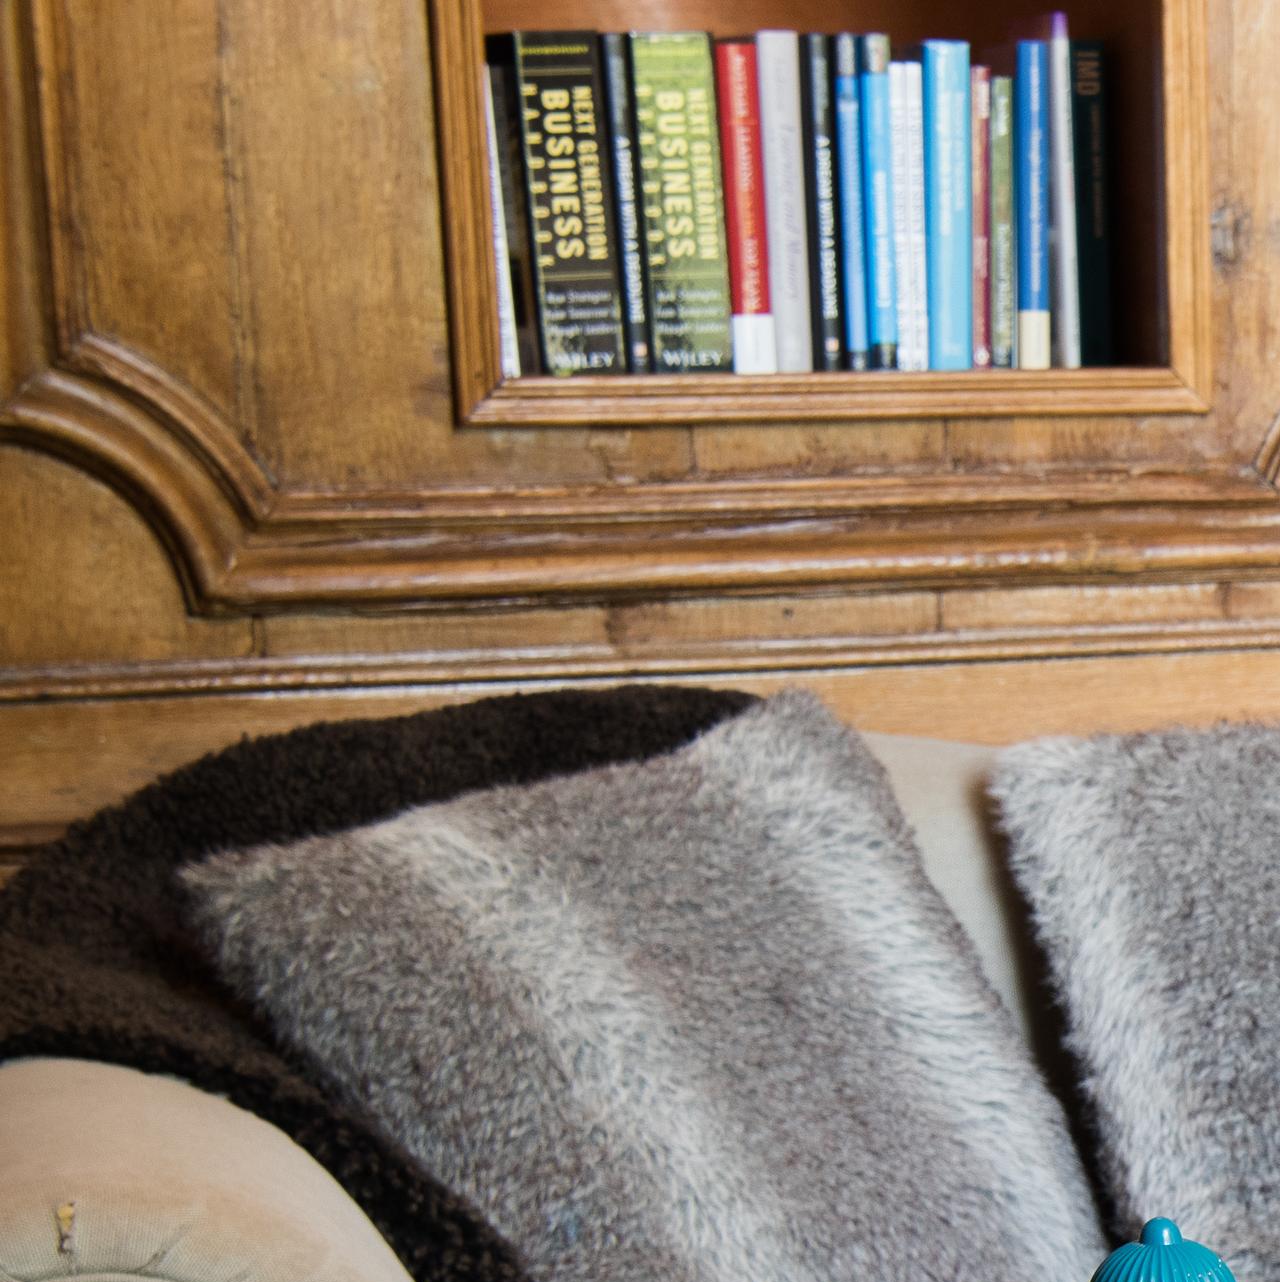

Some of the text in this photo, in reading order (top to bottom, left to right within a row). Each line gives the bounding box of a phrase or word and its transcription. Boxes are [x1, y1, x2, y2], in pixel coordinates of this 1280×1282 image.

[1076, 51, 1100, 96] IMD
[521, 83, 556, 267] HANDBOOK
[540, 88, 586, 259] BUSINESS
[572, 86, 609, 261] NEXT GENERATION
[635, 84, 667, 266] HANDBOOK
[655, 90, 696, 258] BUSINESS
[687, 87, 720, 261] NEXT GENERATION
[815, 148, 833, 199] DREAM
[816, 135, 831, 148] A
[616, 135, 645, 324] A DREAM WITH A DEADLINE
[818, 200, 835, 236] WITH
[820, 236, 835, 249] A
[820, 250, 839, 320] DEADLINE
[553, 351, 616, 370] WILEY
[662, 350, 724, 367] WILEY
